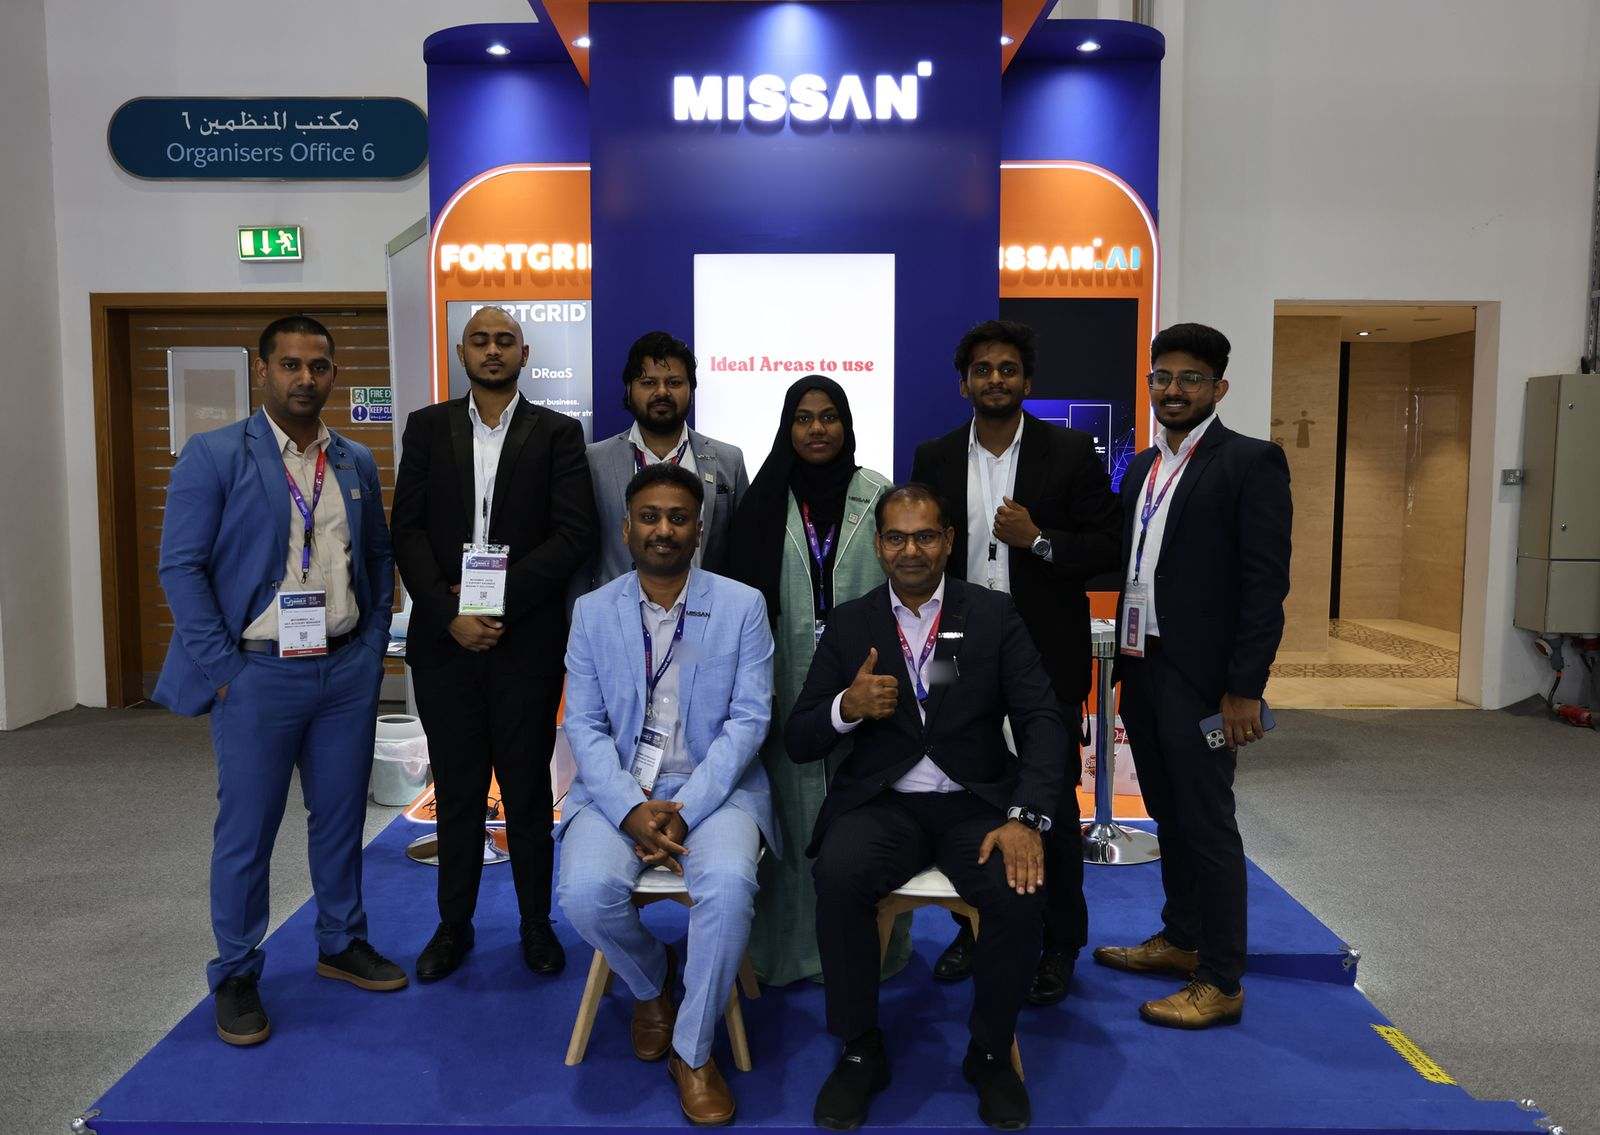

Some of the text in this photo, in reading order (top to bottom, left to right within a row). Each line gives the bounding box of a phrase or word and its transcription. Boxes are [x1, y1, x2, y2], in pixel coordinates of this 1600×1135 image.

[673, 74, 918, 121] MISSAN
[181, 111, 359, 135] مكتب المنظمين ٦
[167, 142, 375, 168] Organisers Office 6
[441, 243, 592, 272] FORTGRI
[531, 368, 574, 379] DRaaS
[710, 356, 874, 372] Ideal Areas to use
[370, 389, 384, 398] FIRE
[546, 397, 580, 406] business.
